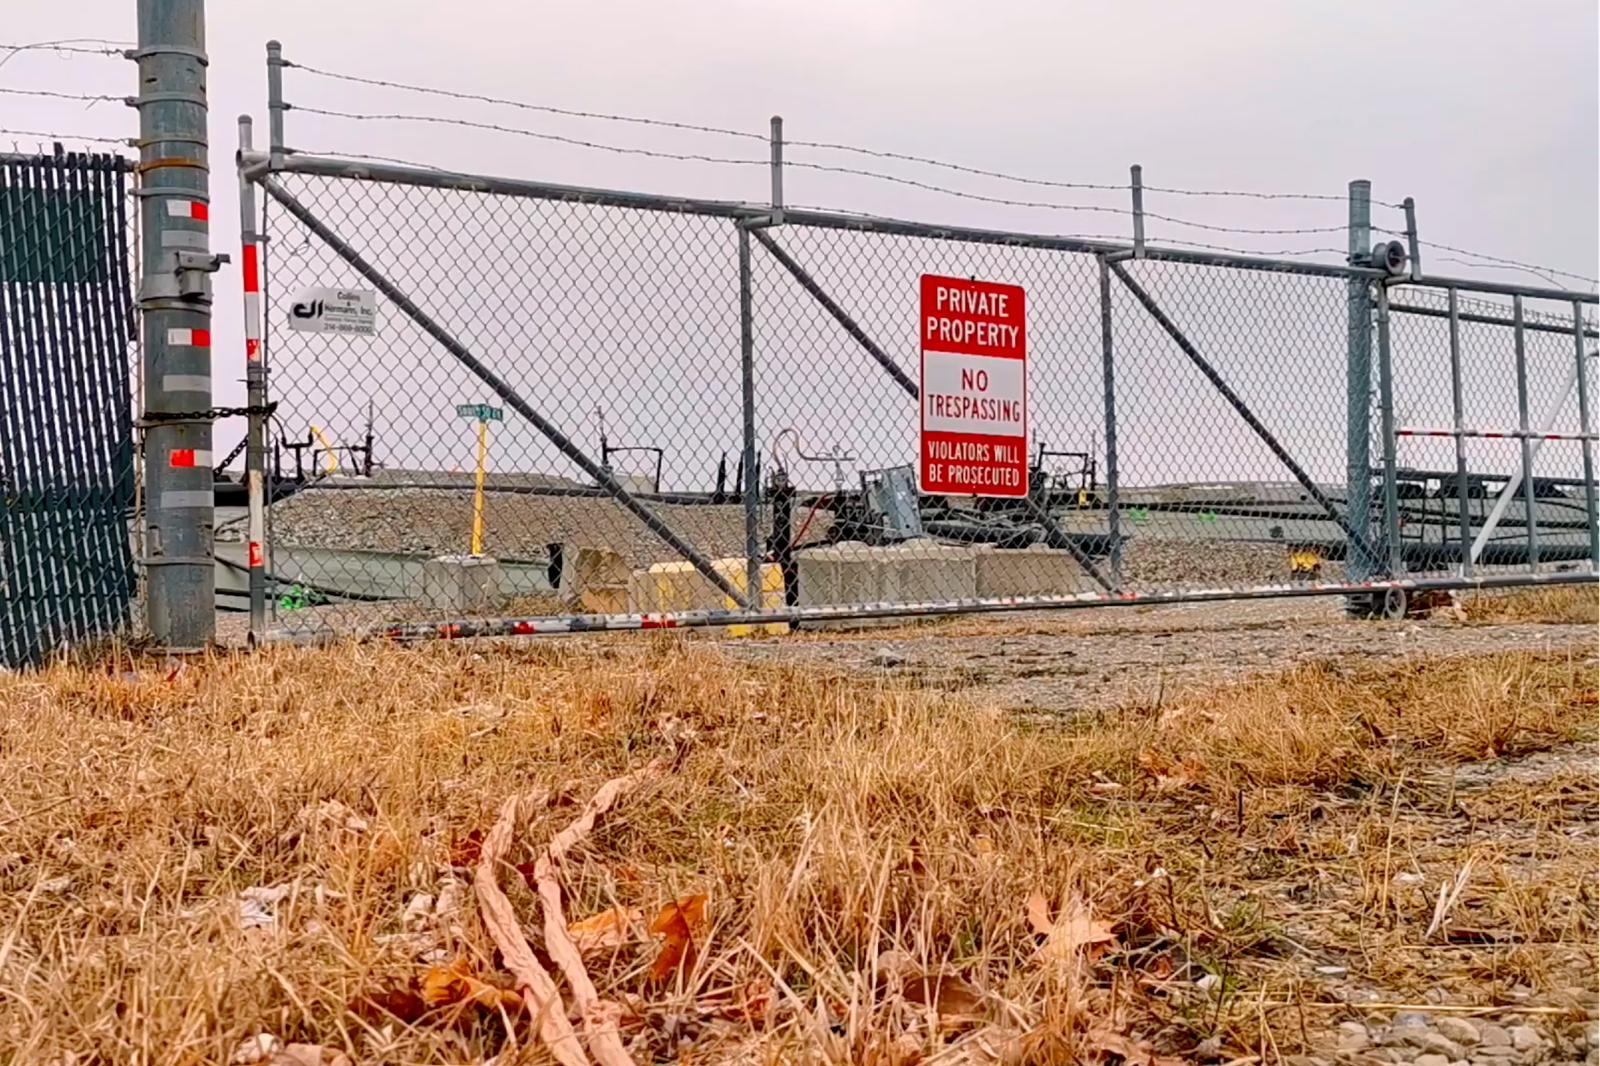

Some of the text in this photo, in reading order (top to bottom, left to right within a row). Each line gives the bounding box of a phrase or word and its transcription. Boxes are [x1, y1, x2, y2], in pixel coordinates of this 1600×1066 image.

[337, 291, 361, 301] Collins
[936, 286, 1009, 318] PRIVATE
[926, 316, 1020, 348] PROPERTY
[961, 368, 988, 392] NO
[927, 394, 1020, 422] TRESPASSING
[928, 440, 1020, 464] VIOLATORS WILL
[929, 463, 1020, 487] BE PROSECUTED
